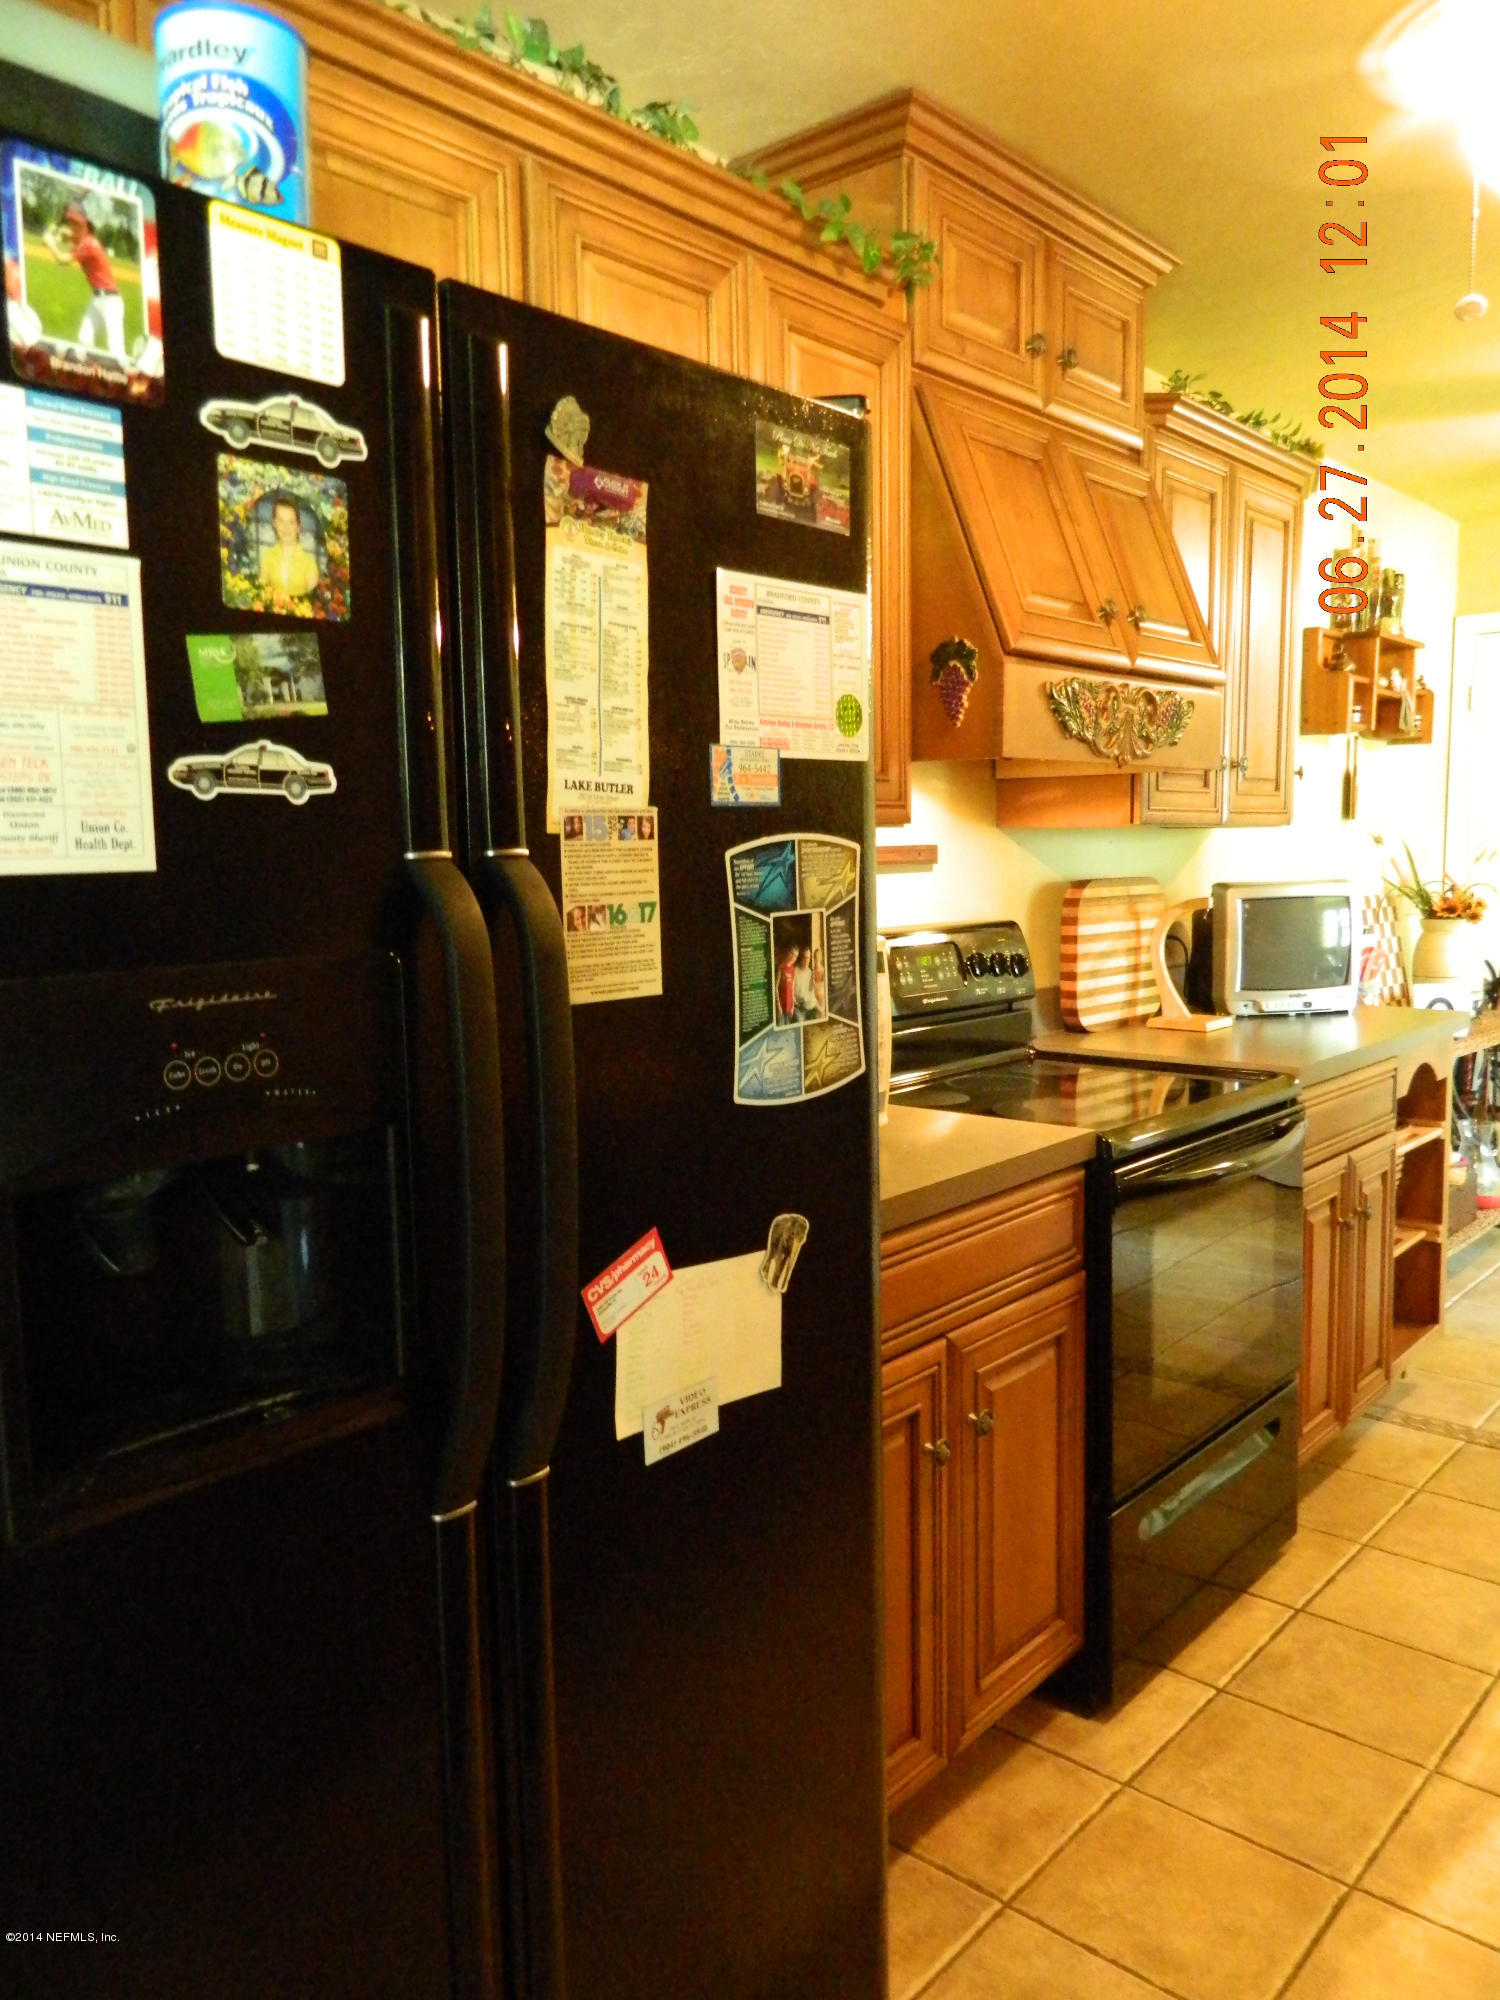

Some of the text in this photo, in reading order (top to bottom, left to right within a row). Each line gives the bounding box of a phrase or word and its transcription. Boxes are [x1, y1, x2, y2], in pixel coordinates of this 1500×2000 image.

[45, 559, 98, 576] COUNTY
[564, 779, 634, 795] LAKE BUTLER
[81, 821, 110, 833] Union
[585, 815, 608, 841] 15
[75, 838, 107, 850] Health
[607, 903, 627, 925] 16
[638, 902, 657, 923] 17
[149, 990, 278, 1013] Frigidaire
[587, 1238, 657, 1303] CVS/pharmacy
[641, 1265, 660, 1289] 24
